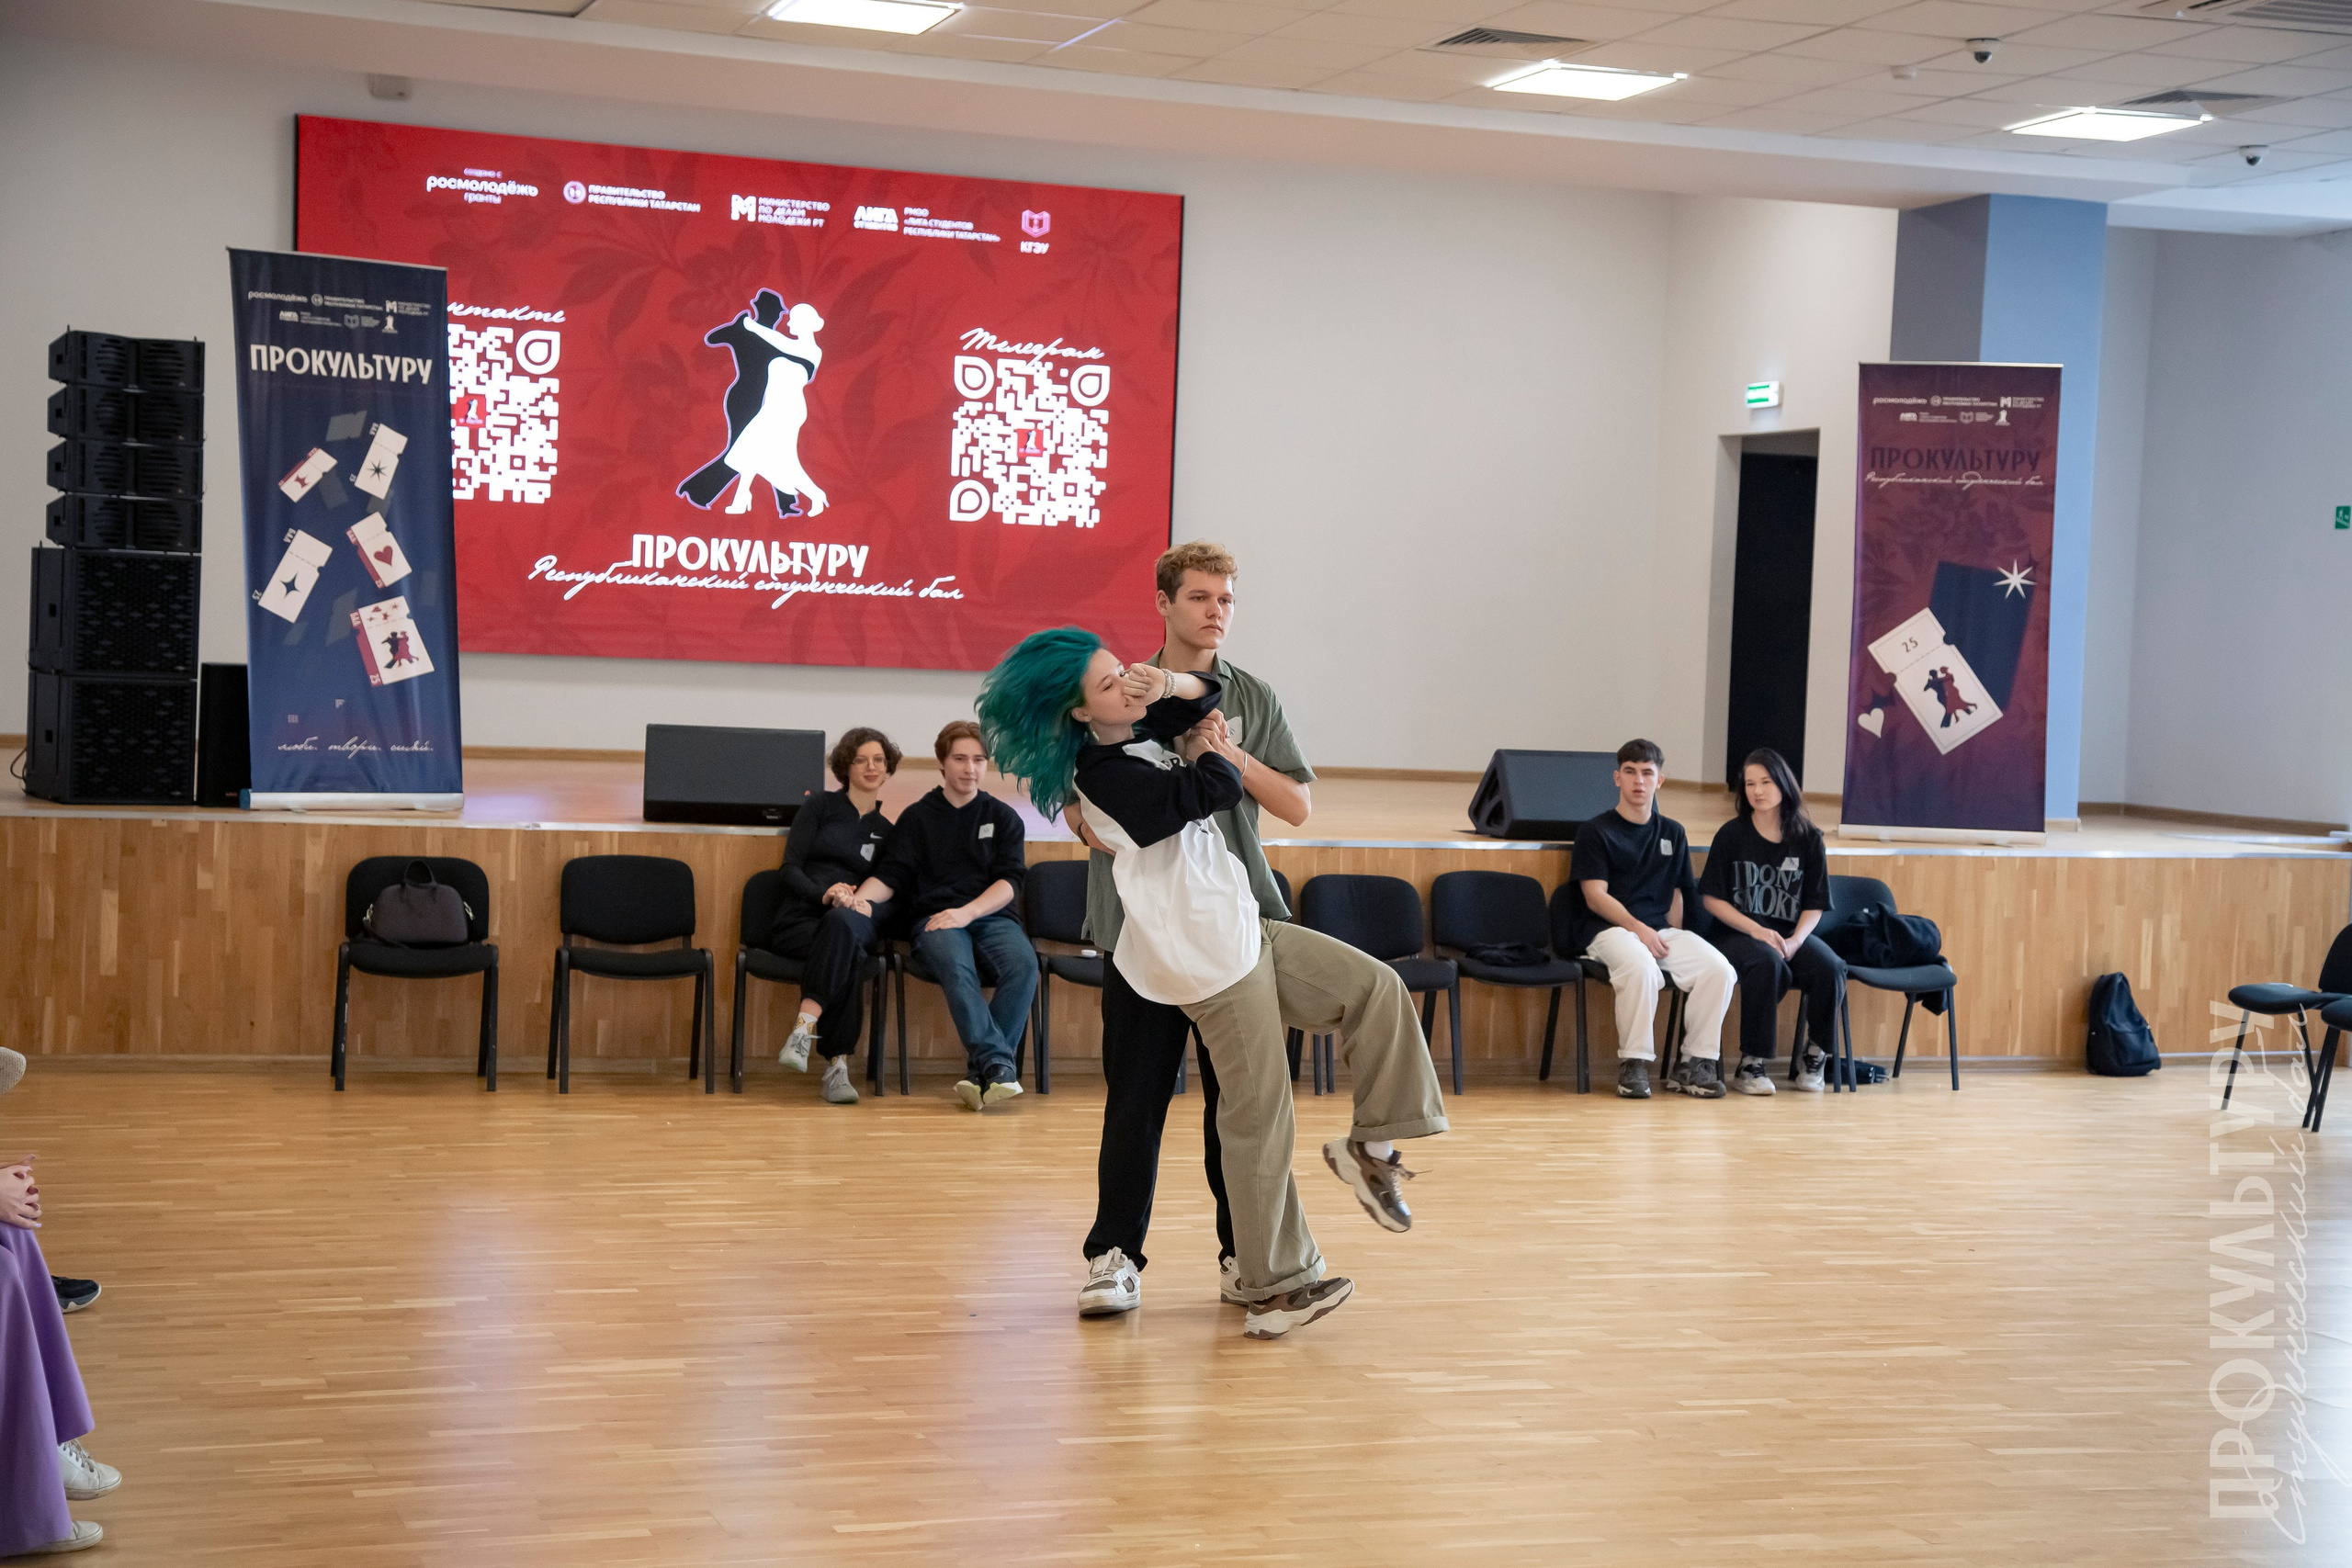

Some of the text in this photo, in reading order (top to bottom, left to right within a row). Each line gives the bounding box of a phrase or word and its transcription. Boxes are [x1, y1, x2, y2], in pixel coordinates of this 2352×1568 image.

[588, 184, 666, 200] ПРАВИТЕЛЬСТВО
[588, 194, 702, 213] РЕСПУБЛИКИ ТАТАРСТАН
[758, 197, 831, 212] МИНИСТЕРСТВО
[758, 205, 807, 218] ПО ДЕЛАМ
[854, 205, 899, 223] ЛИГА
[812, 218, 826, 228] РТ
[929, 220, 975, 231] СТУДЕНТОВ
[903, 226, 956, 239] РЕСПУБЛИКИ
[1020, 241, 1050, 254] КГЭУ
[250, 344, 433, 386] ПРОКУЛЬТУРУ
[1870, 446, 2041, 473] ПРОКУЛЬТУРУ
[631, 533, 870, 579] ПРОКУЛЬТУРУ
[527, 554, 965, 610] Республиканский студенческий бал
[1901, 637, 1918, 653] 25
[1732, 861, 1742, 891] I
